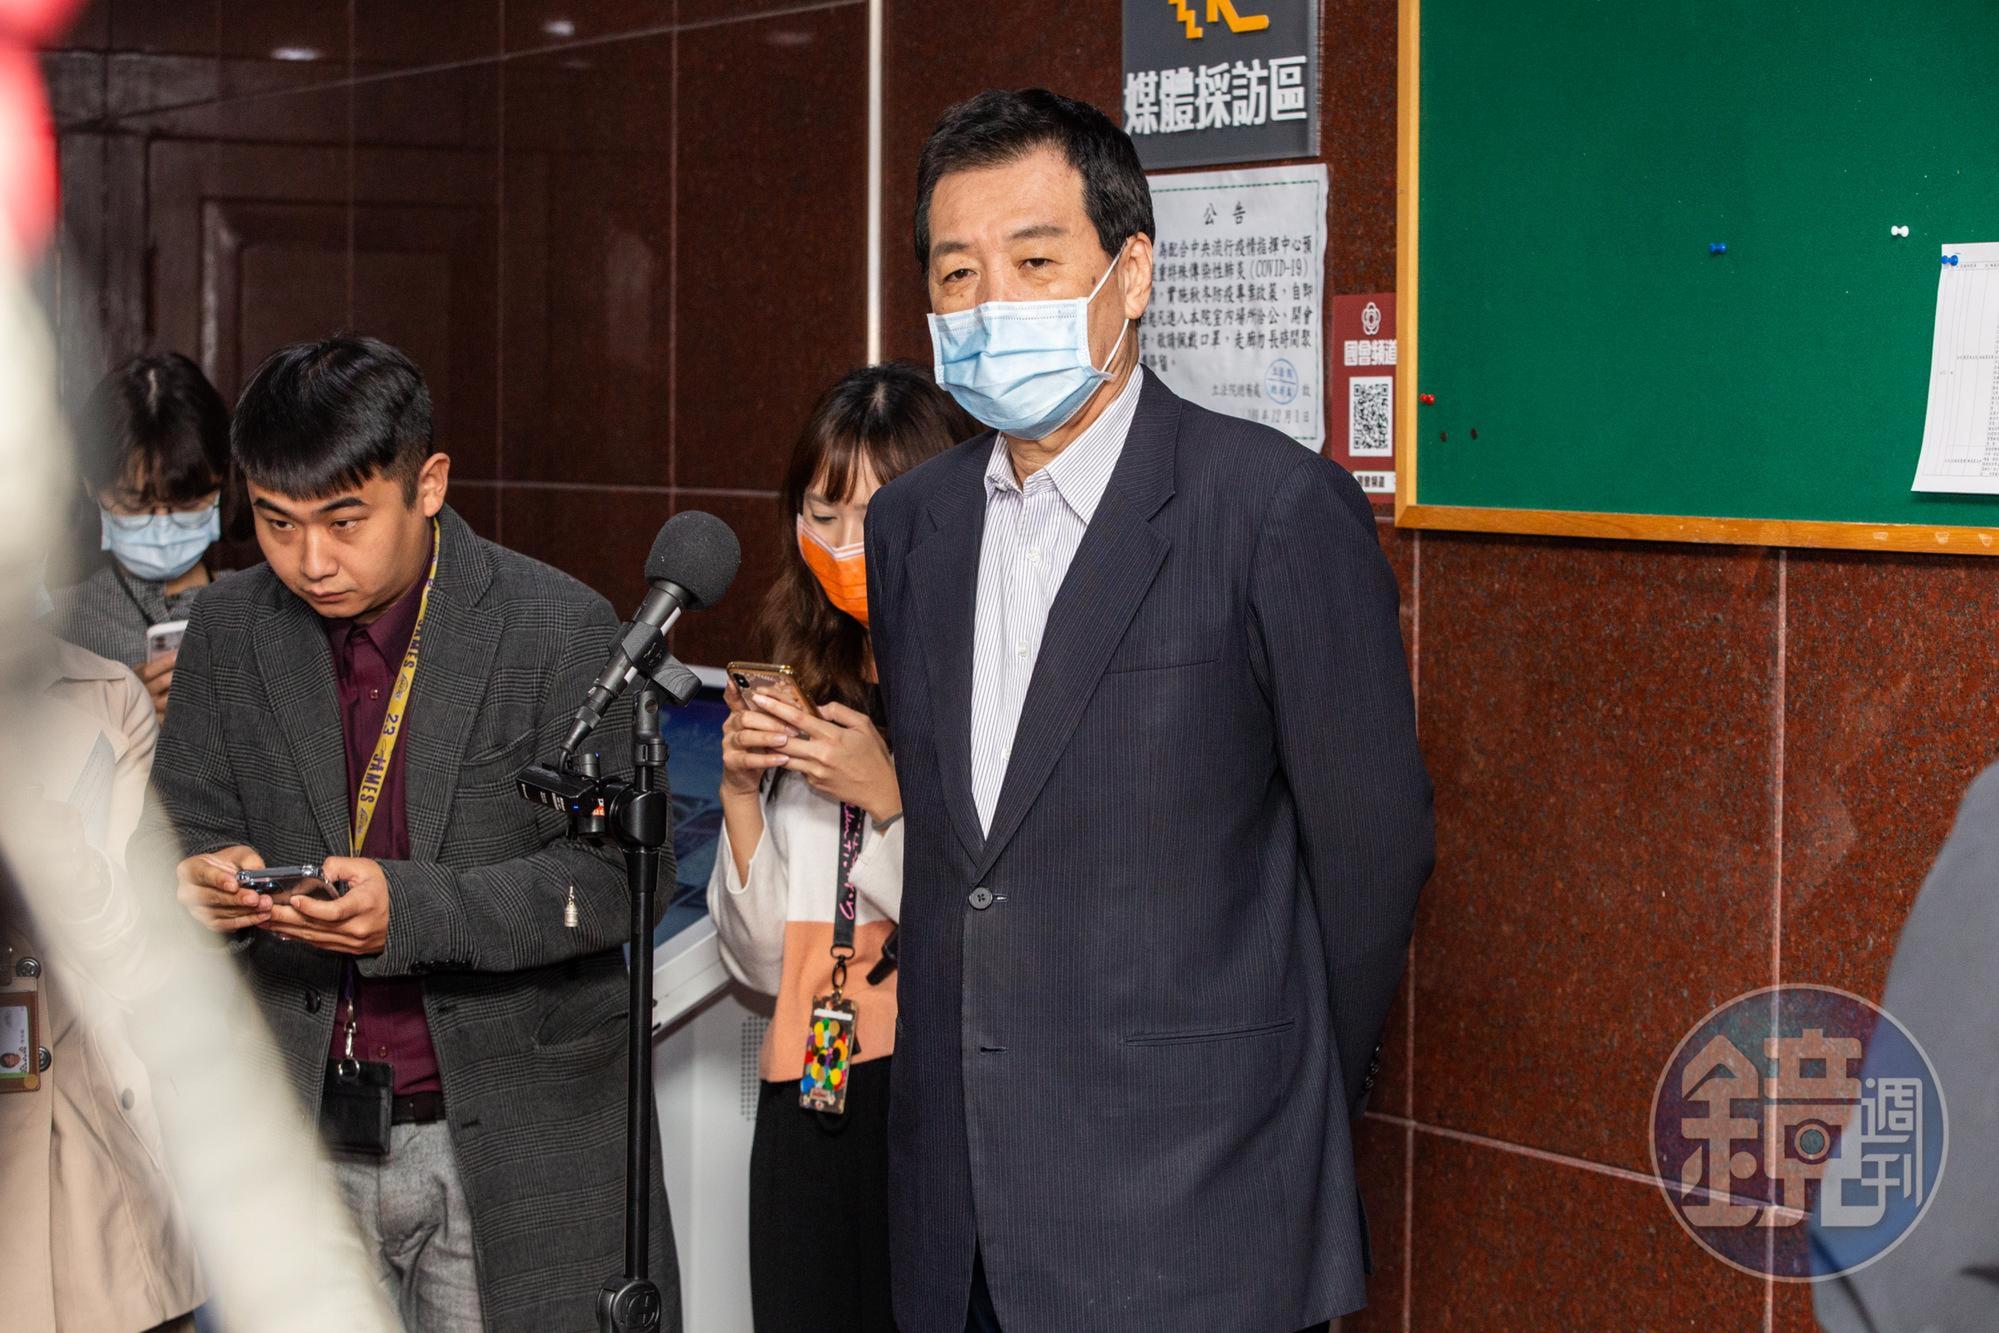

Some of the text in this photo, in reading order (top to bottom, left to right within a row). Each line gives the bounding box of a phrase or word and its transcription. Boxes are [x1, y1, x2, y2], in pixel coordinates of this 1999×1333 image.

[1124, 56, 1307, 136] 媒體採訪區
[383, 713, 399, 735] 23
[360, 752, 386, 803] JAMES
